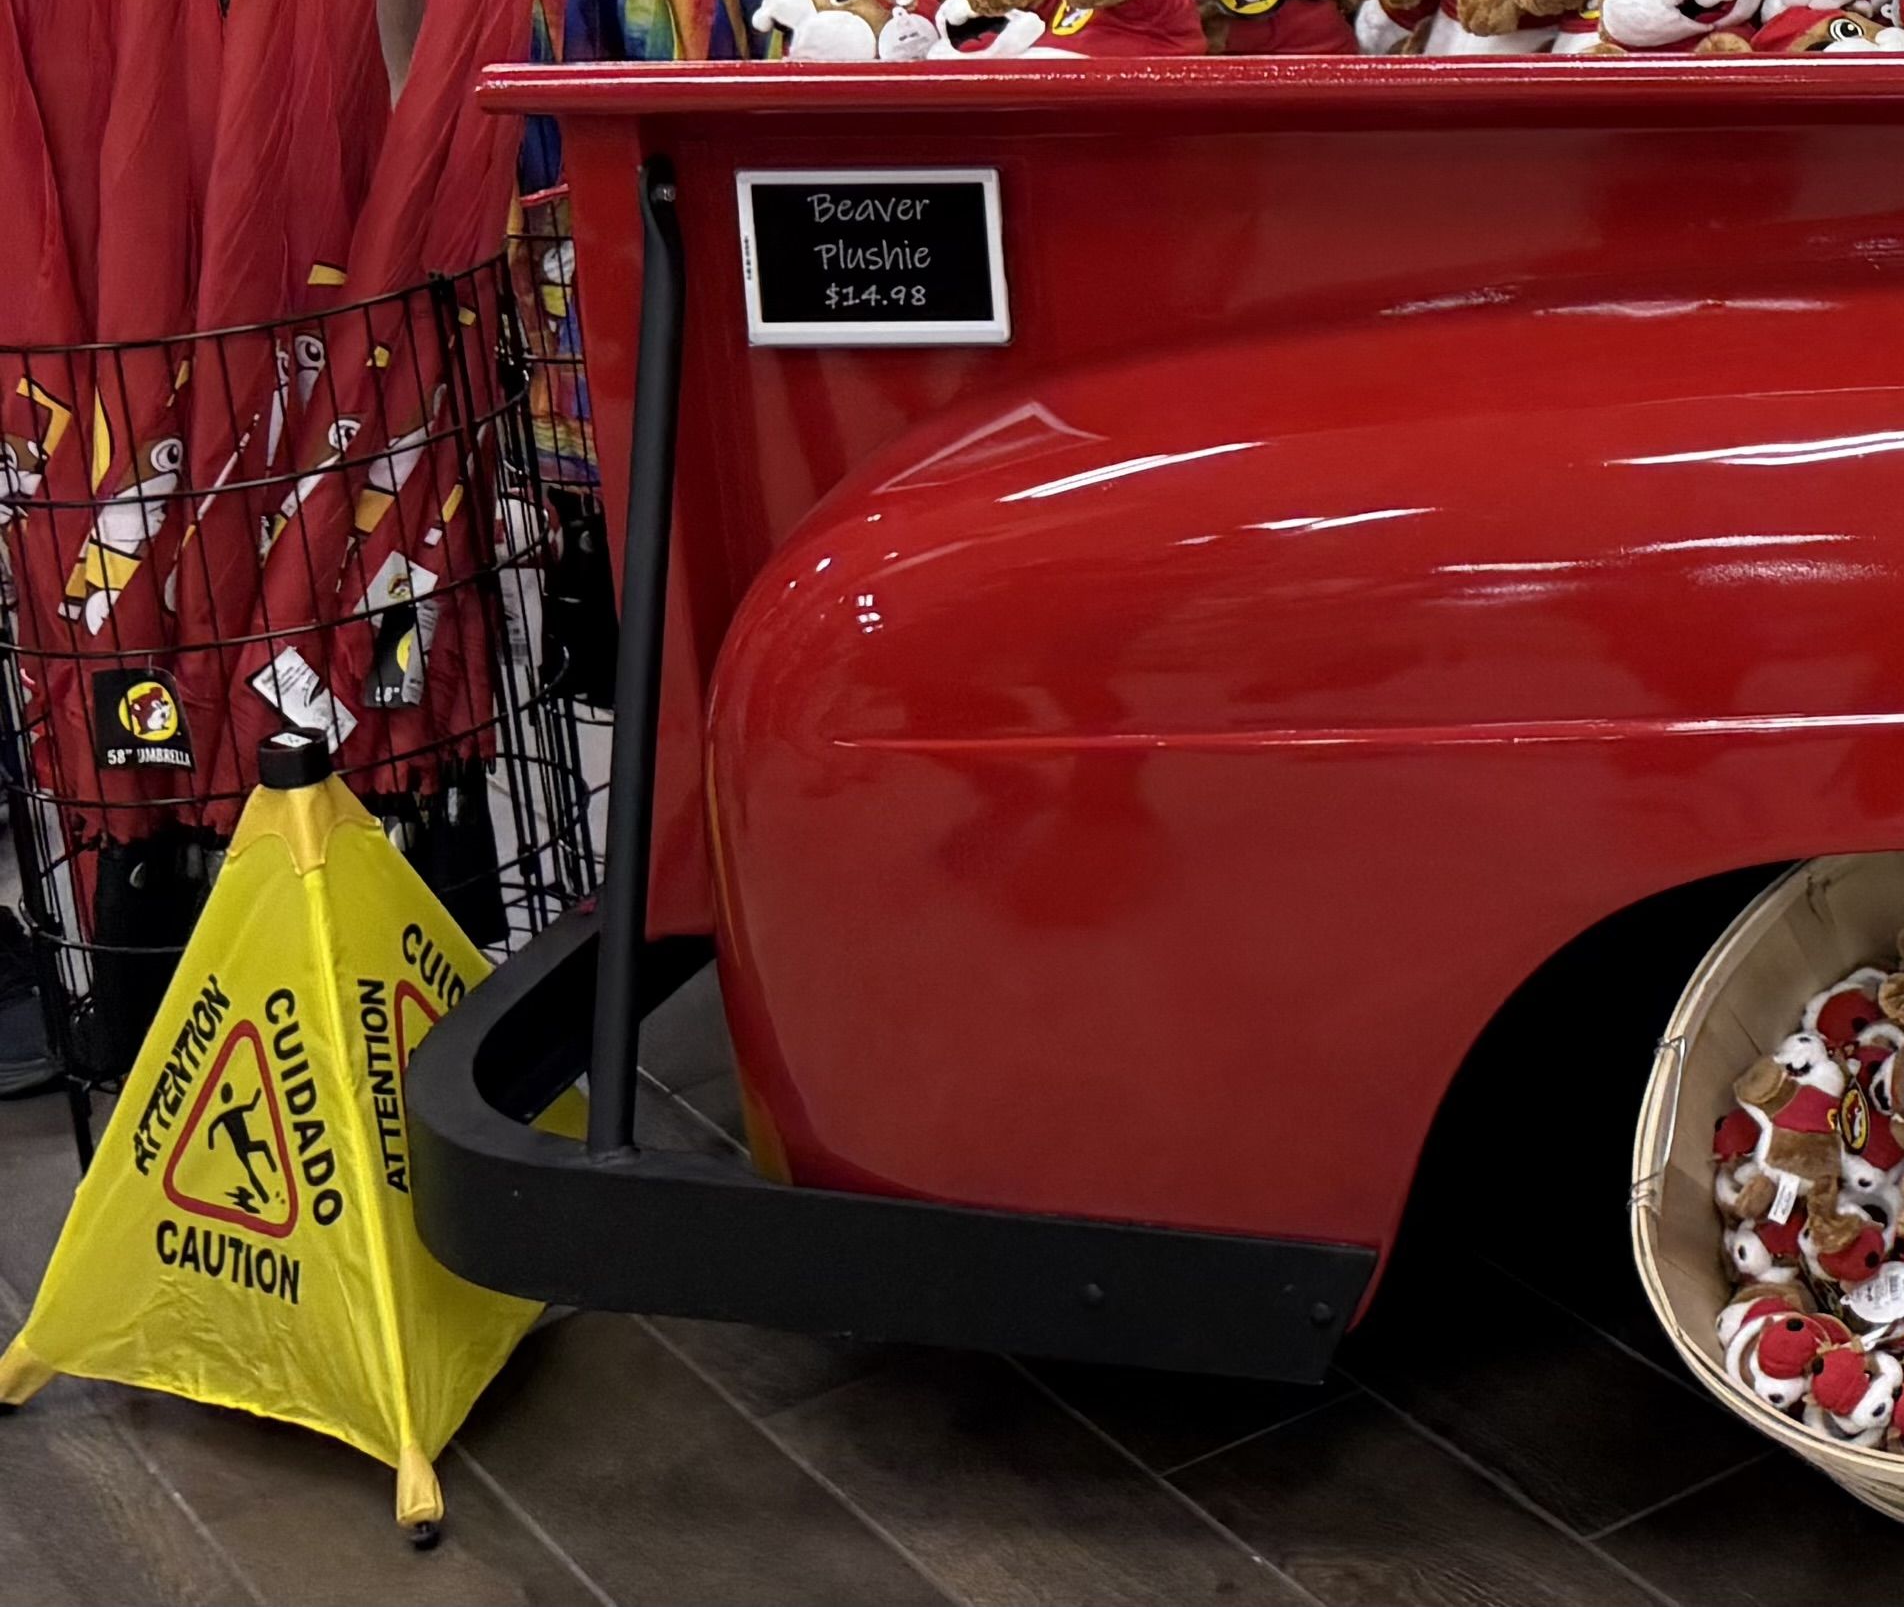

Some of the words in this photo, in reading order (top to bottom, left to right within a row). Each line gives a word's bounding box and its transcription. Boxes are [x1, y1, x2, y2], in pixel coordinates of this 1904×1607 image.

[806, 193, 930, 223] Beaver
[813, 238, 932, 271] Plushie
[825, 282, 927, 309] $14.98
[106, 748, 134, 766] 58"
[136, 746, 193, 768] UMBRELLA
[133, 972, 232, 1178] ATTENTION
[356, 978, 410, 1195] ATTENTION
[264, 987, 344, 1227] CUIDADO
[155, 1218, 301, 1306] CAUTION
